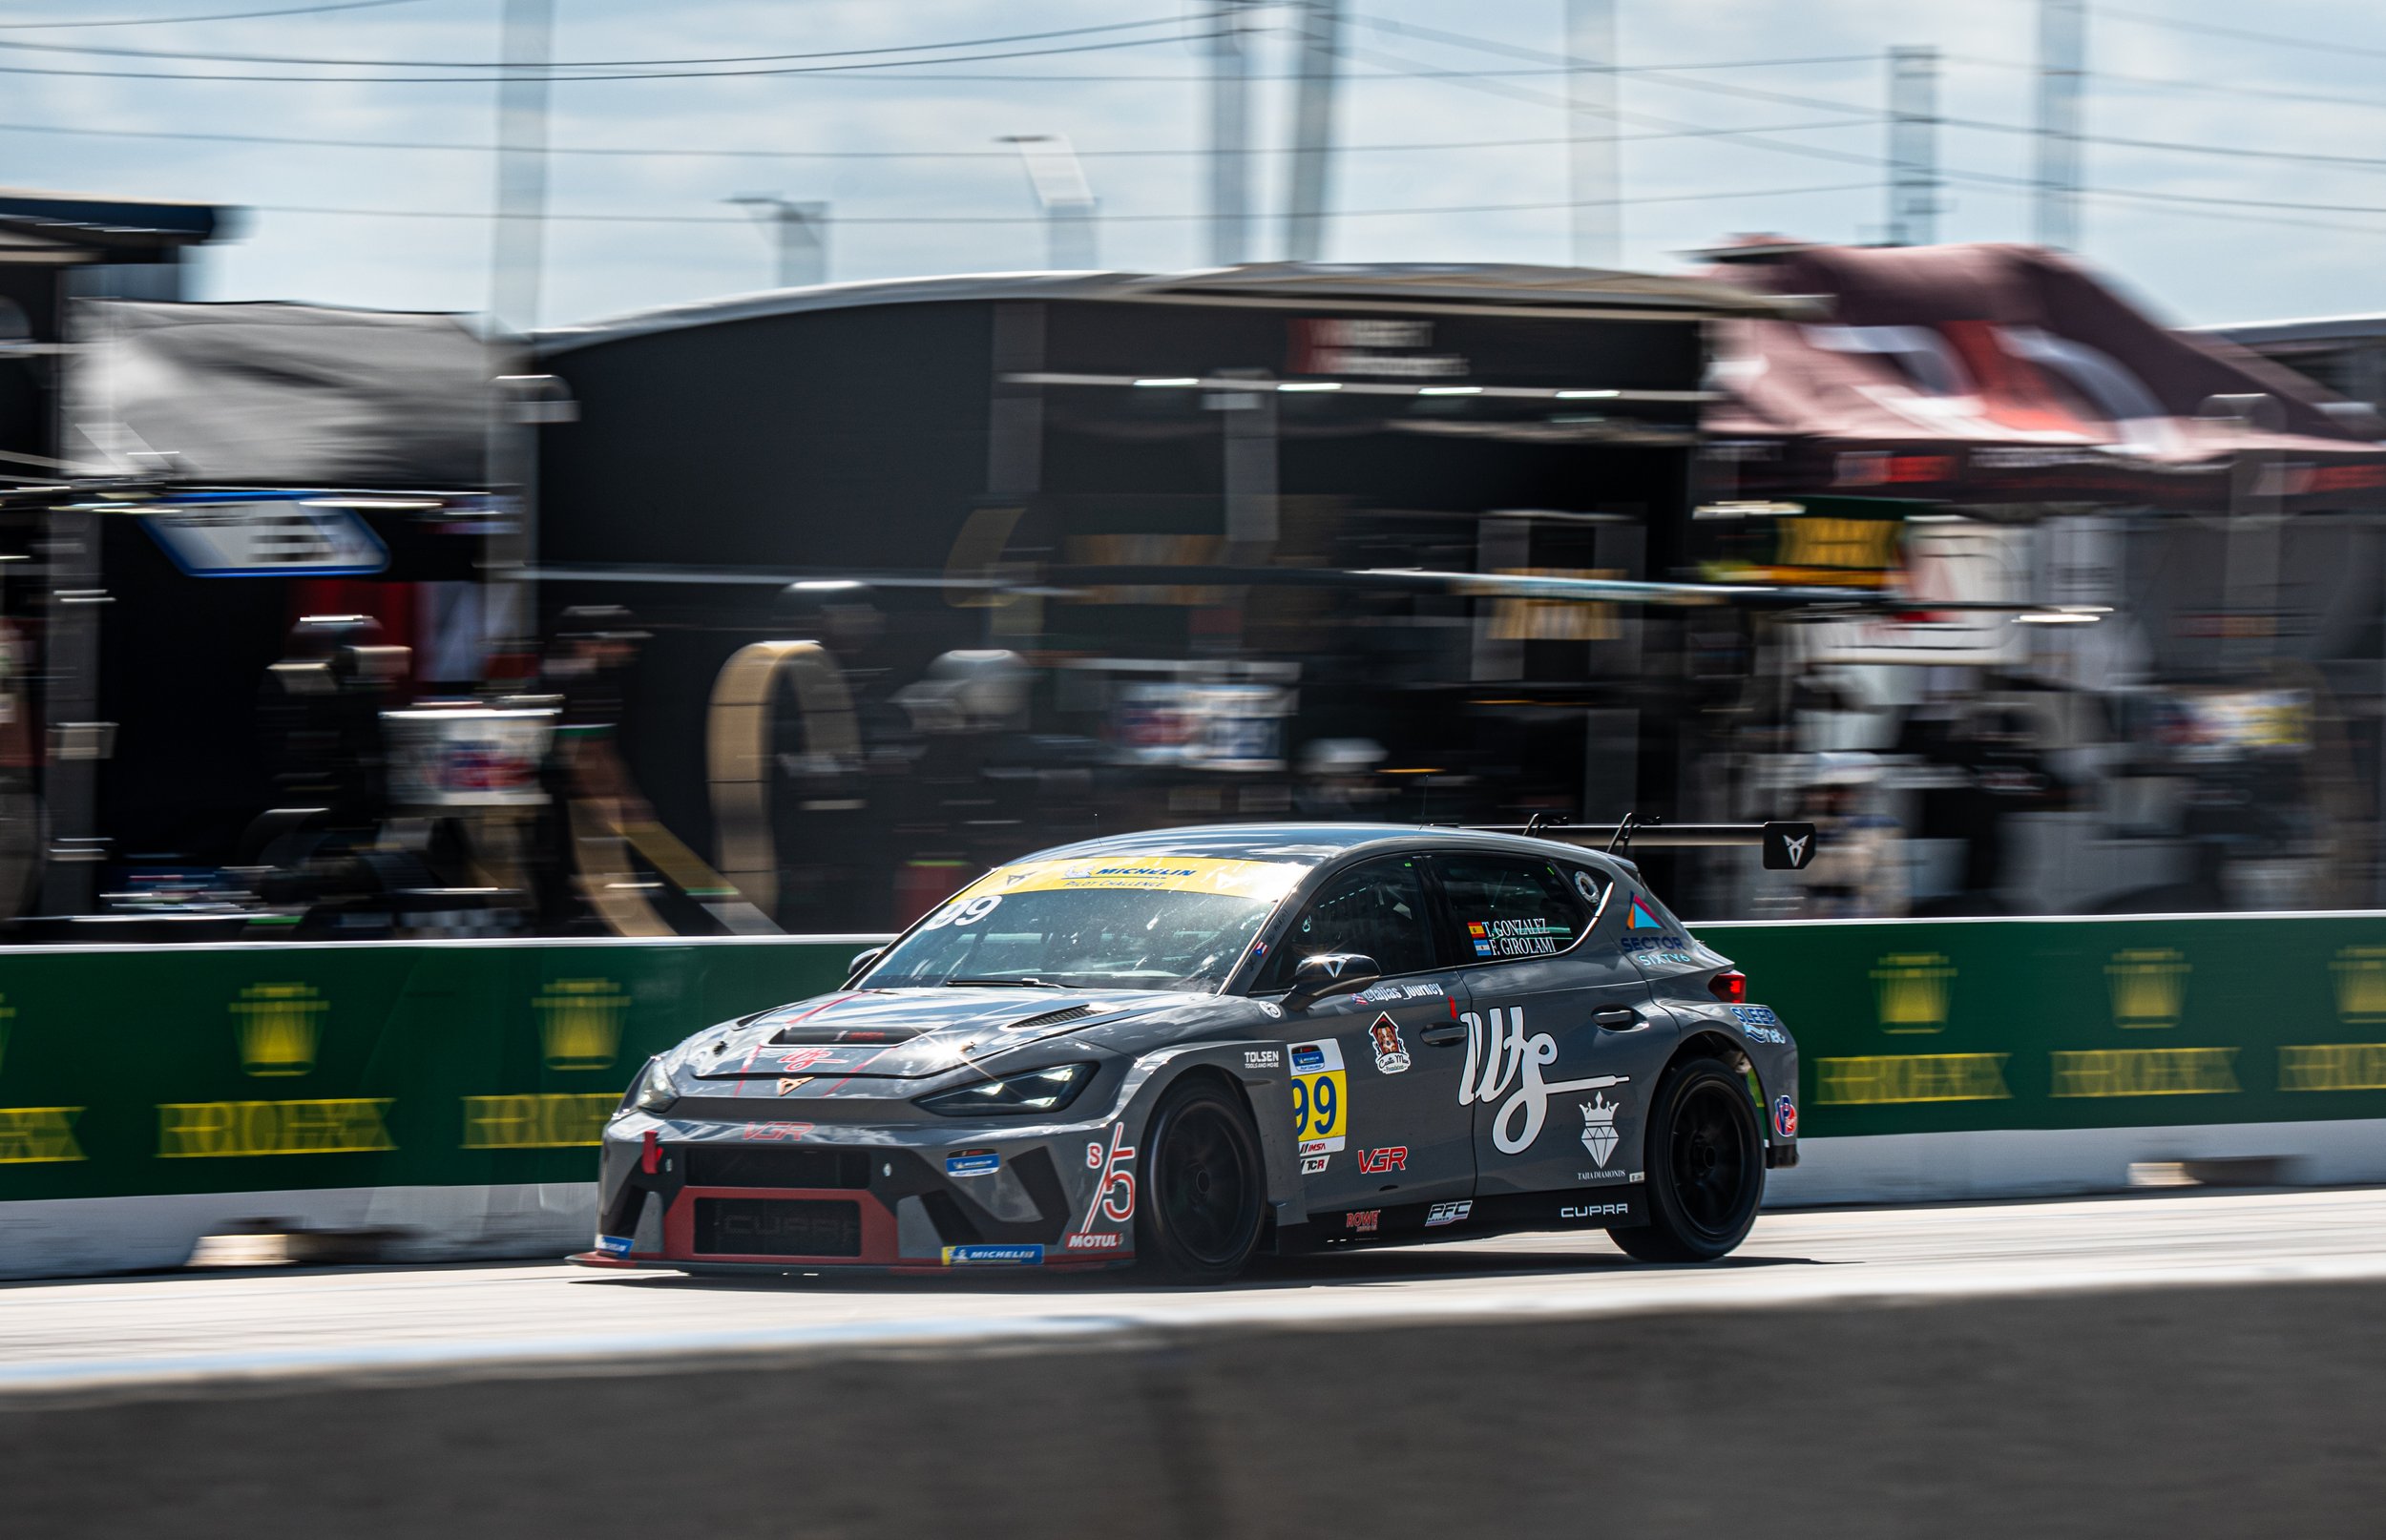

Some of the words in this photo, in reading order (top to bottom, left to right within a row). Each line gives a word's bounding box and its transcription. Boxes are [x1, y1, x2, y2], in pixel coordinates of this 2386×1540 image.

[1096, 867, 1197, 876] MICHELIN
[924, 895, 1002, 930] 99
[1481, 921, 1495, 937] T.
[1494, 918, 1550, 937] GONZALEZ
[1489, 939, 1500, 956] F.
[1500, 936, 1557, 955] GIROLAMI
[1621, 936, 1686, 952] SECTOR
[1639, 953, 1690, 966] SIXTY6
[1730, 1007, 1775, 1025] SLEEP
[1244, 1051, 1279, 1063] TOLSEN
[1291, 1075, 1337, 1137] 99
[742, 1121, 814, 1141] VGR
[1308, 1143, 1327, 1153] IMSA
[1307, 1159, 1325, 1171] TCR
[1357, 1145, 1408, 1175] VGR
[1594, 1169, 1626, 1178] DIAMONDS
[1429, 1200, 1473, 1219] PFC
[1560, 1203, 1628, 1217] CUPRA
[1346, 1210, 1379, 1228] ROWE
[1068, 1235, 1118, 1248] MOTUL
[970, 1251, 1036, 1259] MICHELIN
